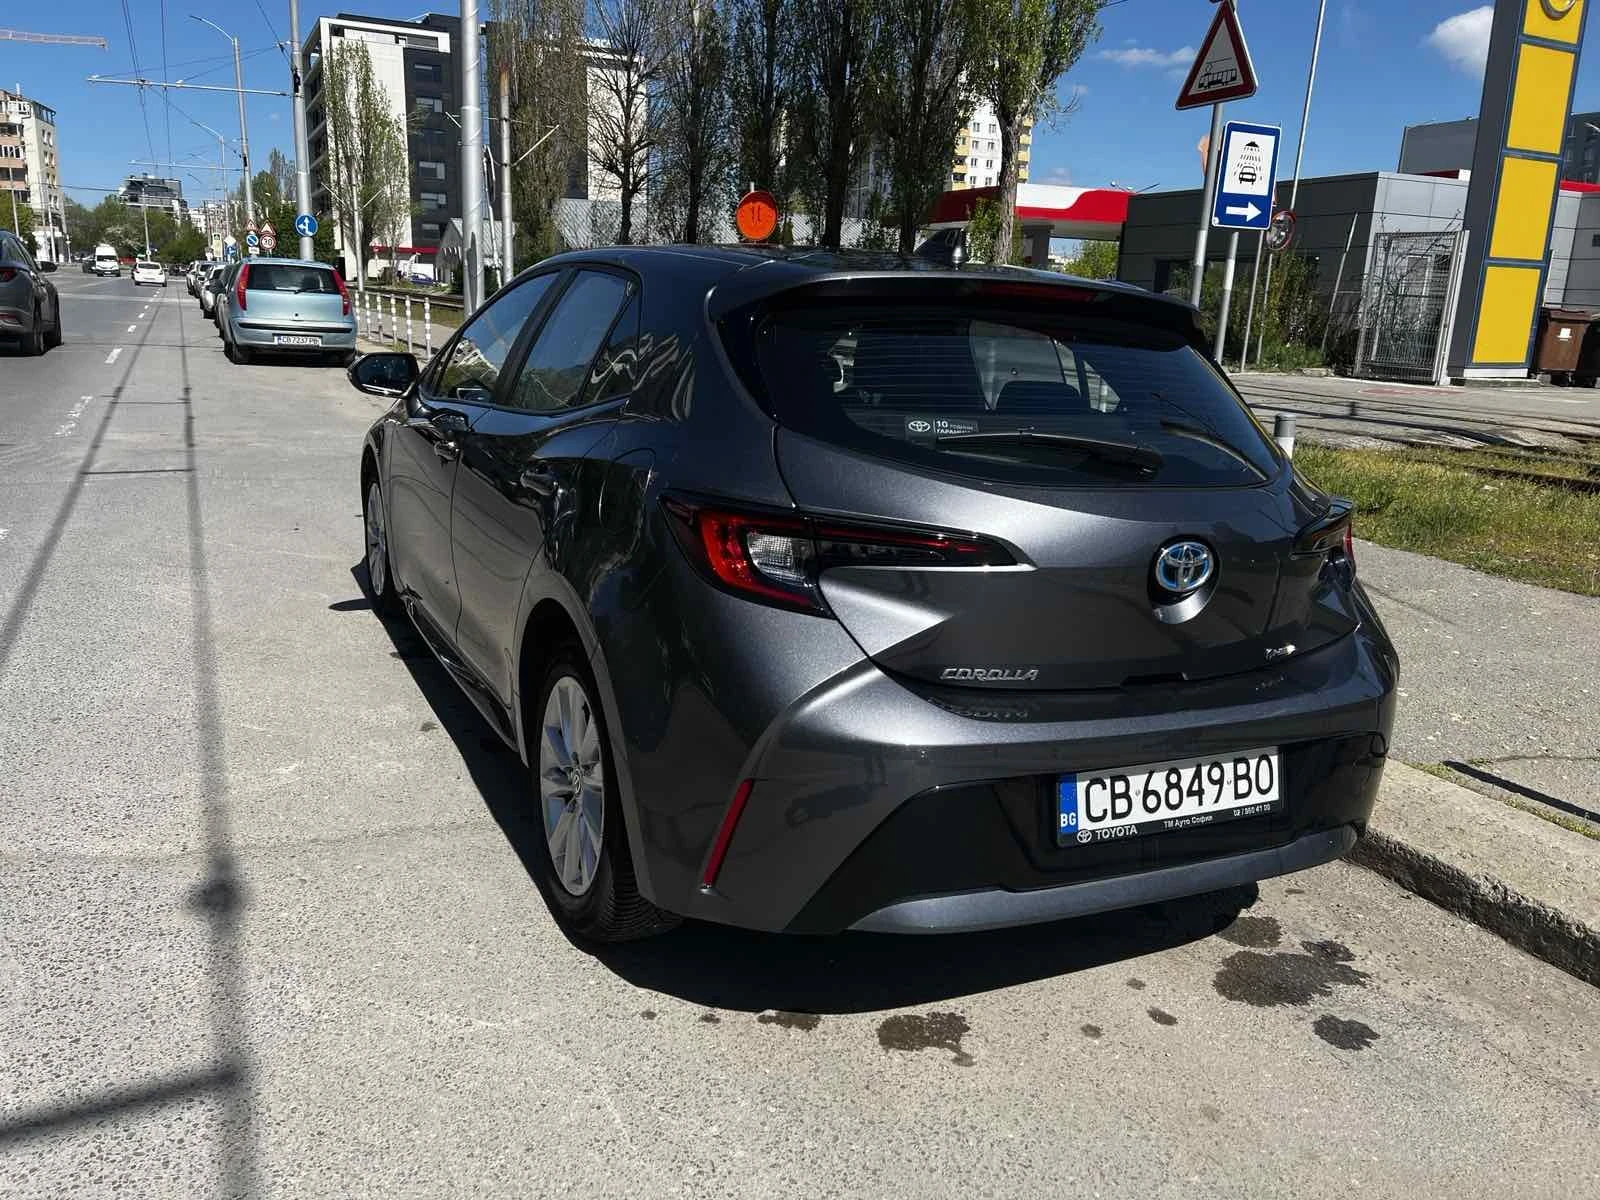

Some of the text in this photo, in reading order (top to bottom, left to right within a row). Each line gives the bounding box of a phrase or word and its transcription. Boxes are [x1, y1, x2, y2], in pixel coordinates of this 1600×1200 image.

[263, 238, 272, 246] 30
[936, 420, 948, 428] 10
[940, 667, 1040, 681] COROLLA
[1085, 754, 1274, 823] CB 6849 BO
[1060, 812, 1077, 828] BG
[1095, 824, 1138, 841] TOYOTA
